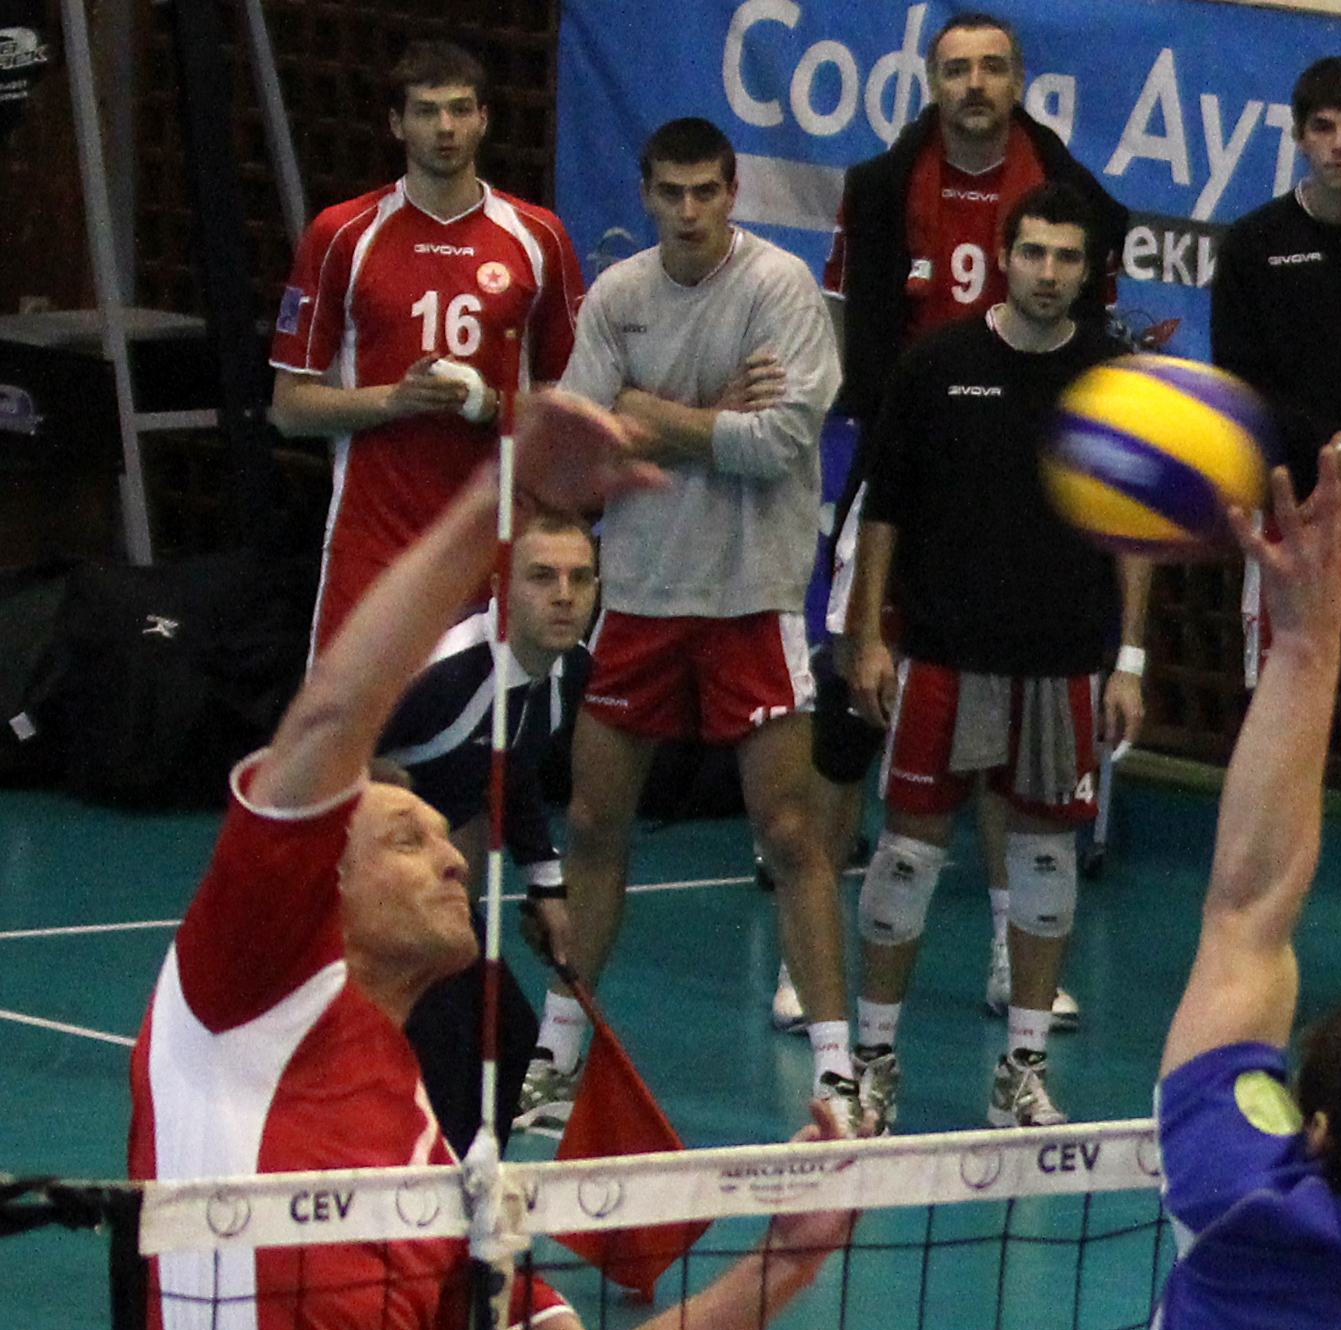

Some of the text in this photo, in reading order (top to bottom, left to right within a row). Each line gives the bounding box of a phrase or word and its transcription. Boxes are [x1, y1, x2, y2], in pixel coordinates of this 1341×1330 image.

[722, 0, 1076, 149] Софя
[413, 243, 476, 257] GIVOVA
[1267, 252, 1322, 266] GIVOVA
[951, 243, 987, 304] 9
[411, 290, 492, 357] 16
[948, 385, 1002, 397] GIVOVA
[1038, 1141, 1101, 1174] CEV
[290, 1189, 354, 1225] CEV
